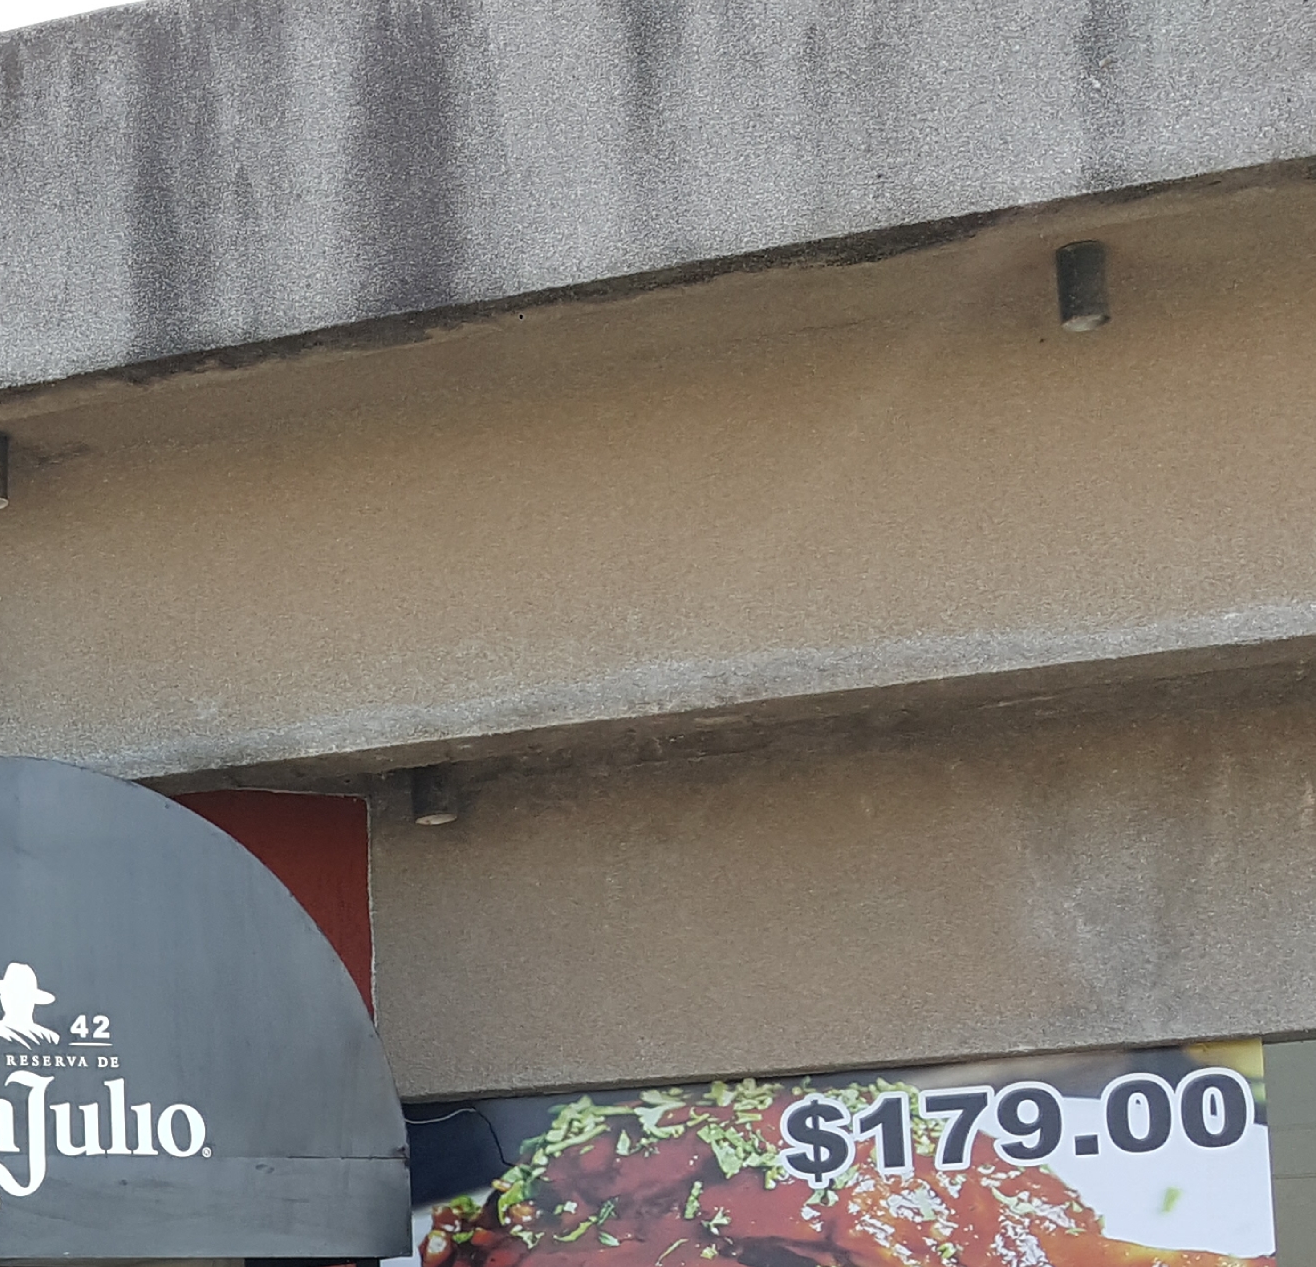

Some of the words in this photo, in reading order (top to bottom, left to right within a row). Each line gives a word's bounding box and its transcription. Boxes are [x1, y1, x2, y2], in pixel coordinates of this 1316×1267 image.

[70, 1015, 111, 1039] 42
[6, 1055, 88, 1068] RESERVA
[97, 1056, 120, 1068] DE
[784, 1071, 1251, 1182] $179.00
